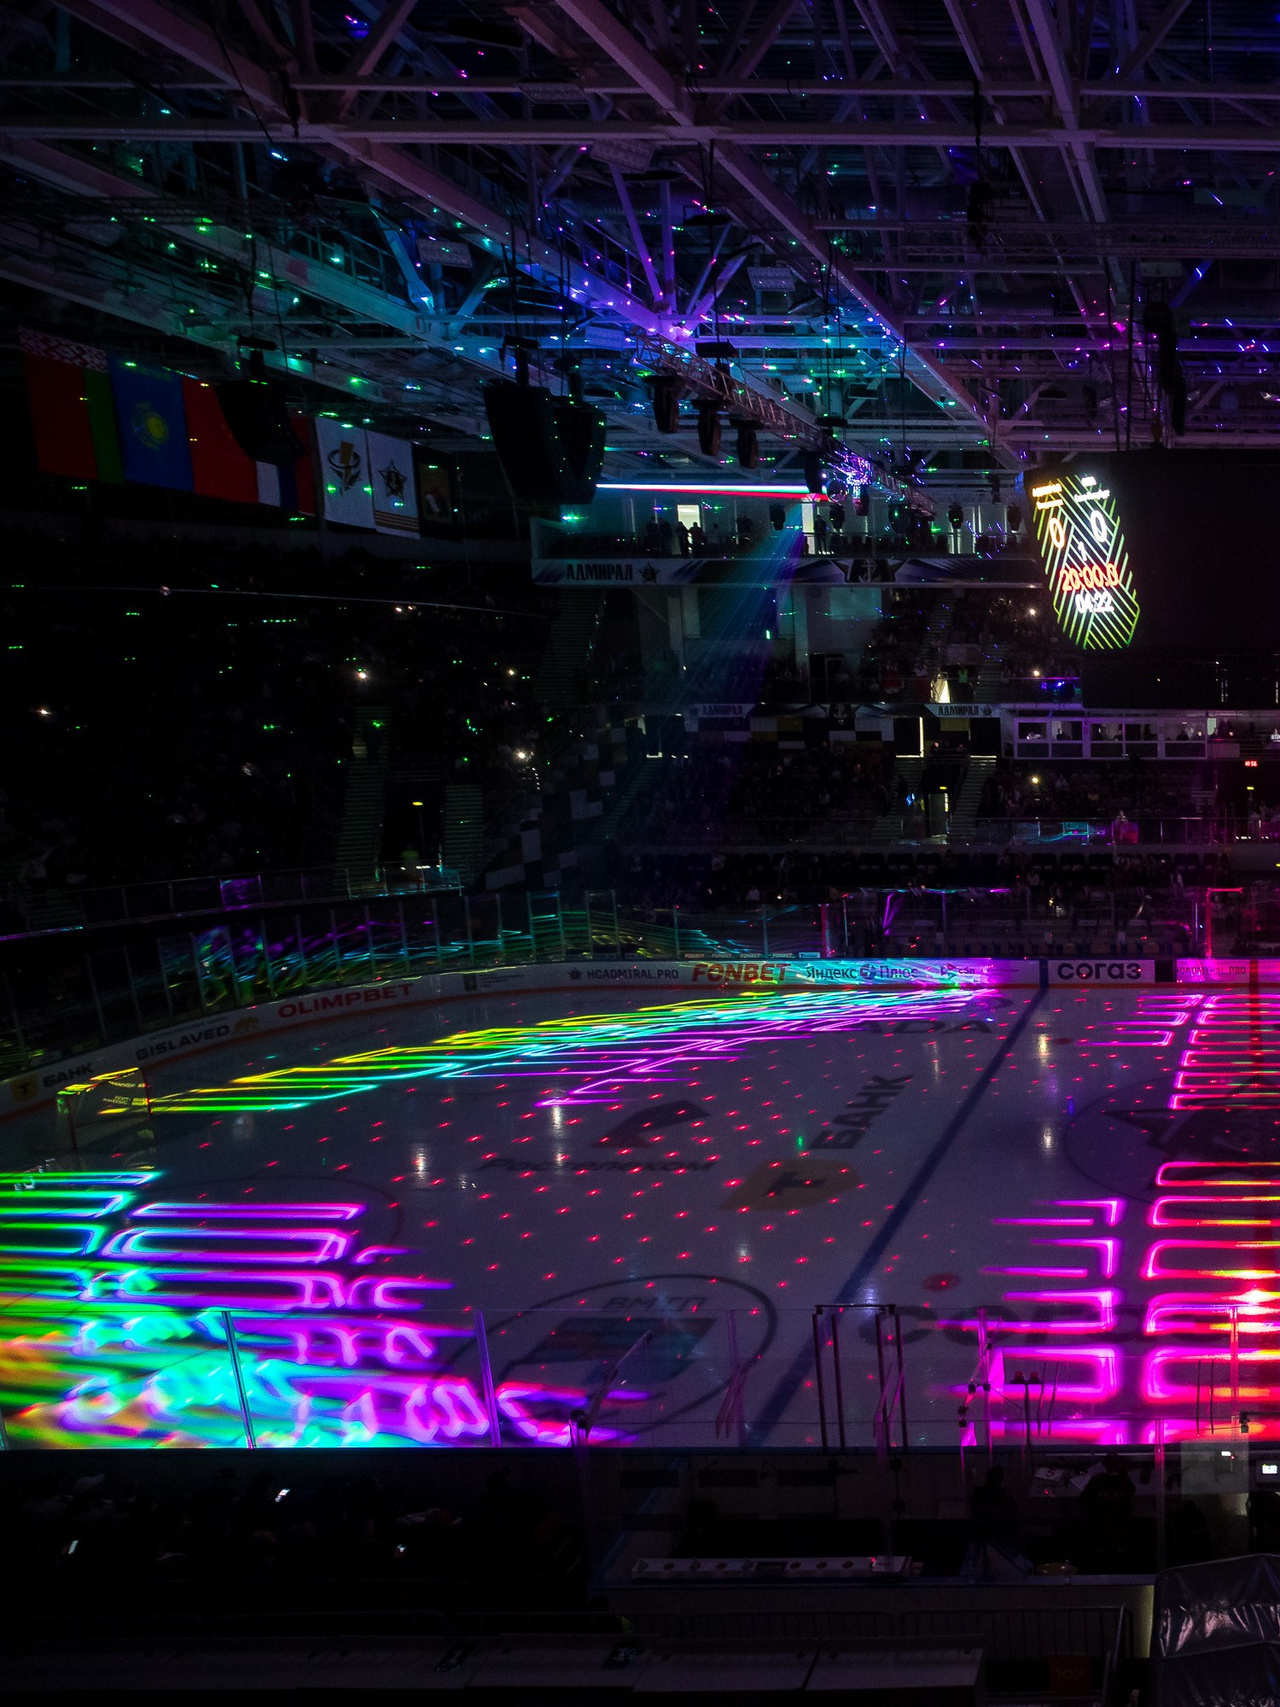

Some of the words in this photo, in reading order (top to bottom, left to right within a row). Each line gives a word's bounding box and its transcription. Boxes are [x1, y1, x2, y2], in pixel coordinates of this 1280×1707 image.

[1050, 518, 1065, 549] 0
[1090, 510, 1107, 542] 0
[566, 563, 633, 581] АДМИРАЛ
[938, 705, 978, 716] АДМИРАЛ
[587, 969, 679, 980] HCADMIRAL.PRO
[692, 963, 791, 982] FONBET
[806, 966, 858, 980] Яндекс
[1057, 962, 1141, 980] согаз
[277, 983, 413, 1019] OLIMPBET
[136, 1023, 230, 1061] GISLAVED
[43, 1063, 94, 1089] БАНК
[809, 1074, 914, 1150] БАНК
[478, 1156, 716, 1173] Ростелеком
